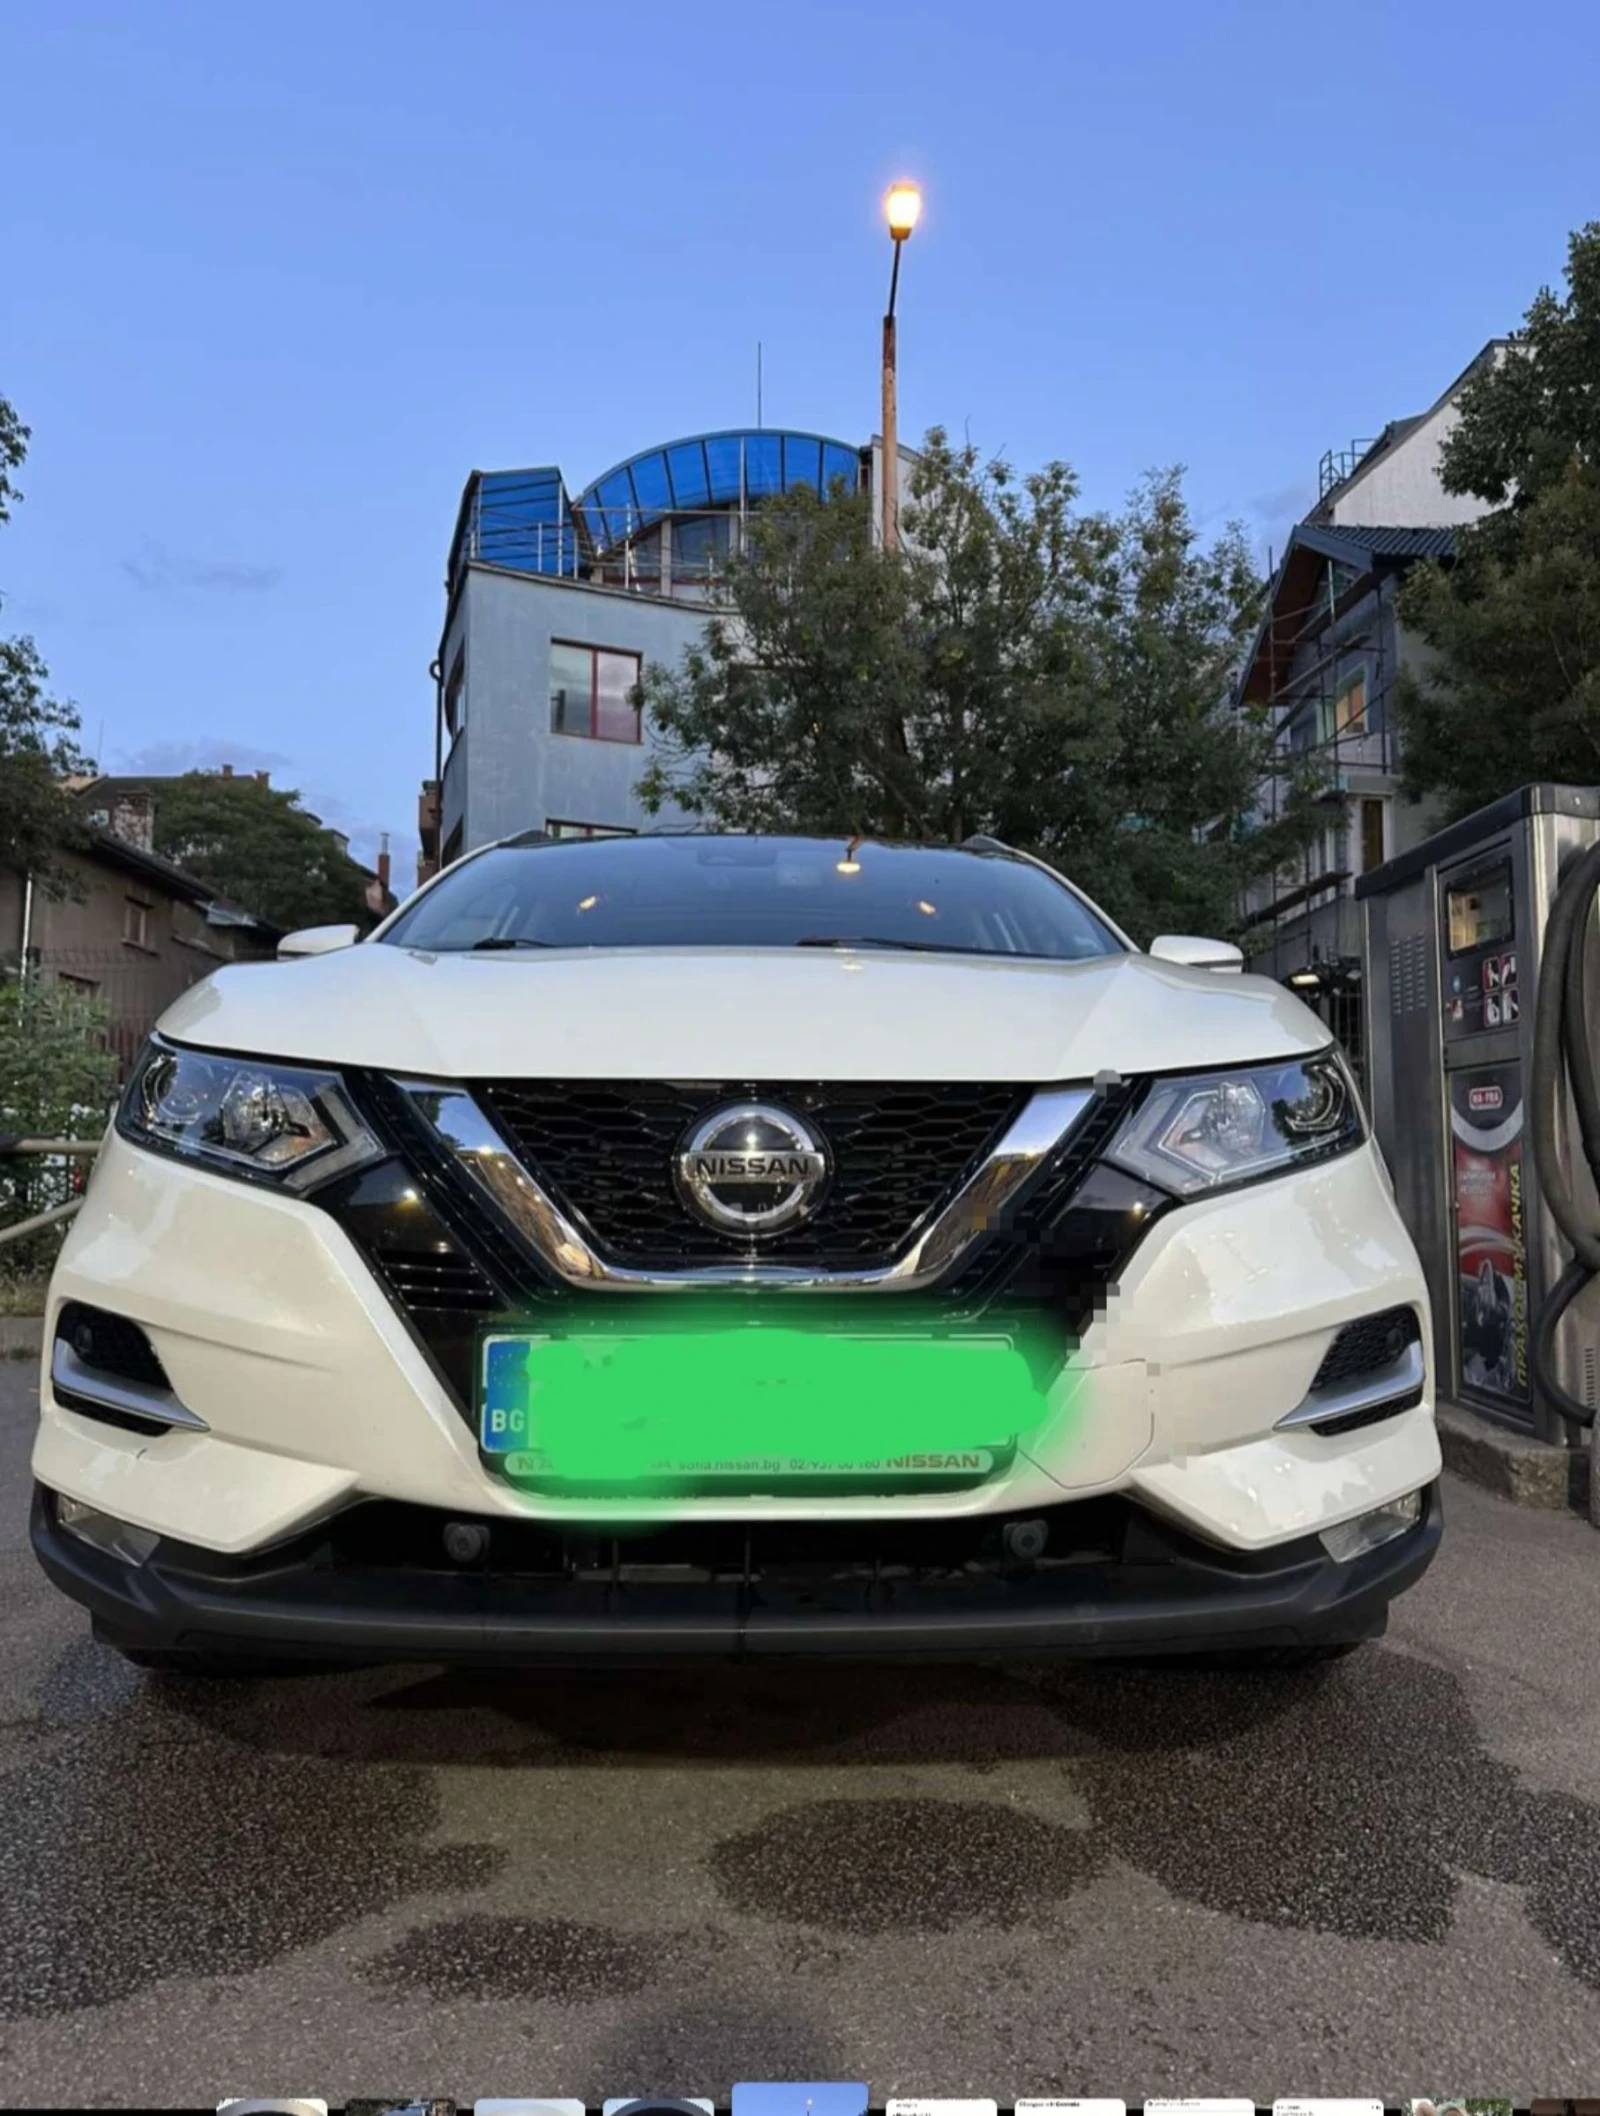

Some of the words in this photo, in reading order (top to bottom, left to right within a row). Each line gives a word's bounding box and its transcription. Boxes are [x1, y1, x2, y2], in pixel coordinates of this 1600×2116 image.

[695, 1157, 809, 1176] NISSAN
[491, 1408, 526, 1433] BG
[885, 1453, 980, 1469] NISSAN
